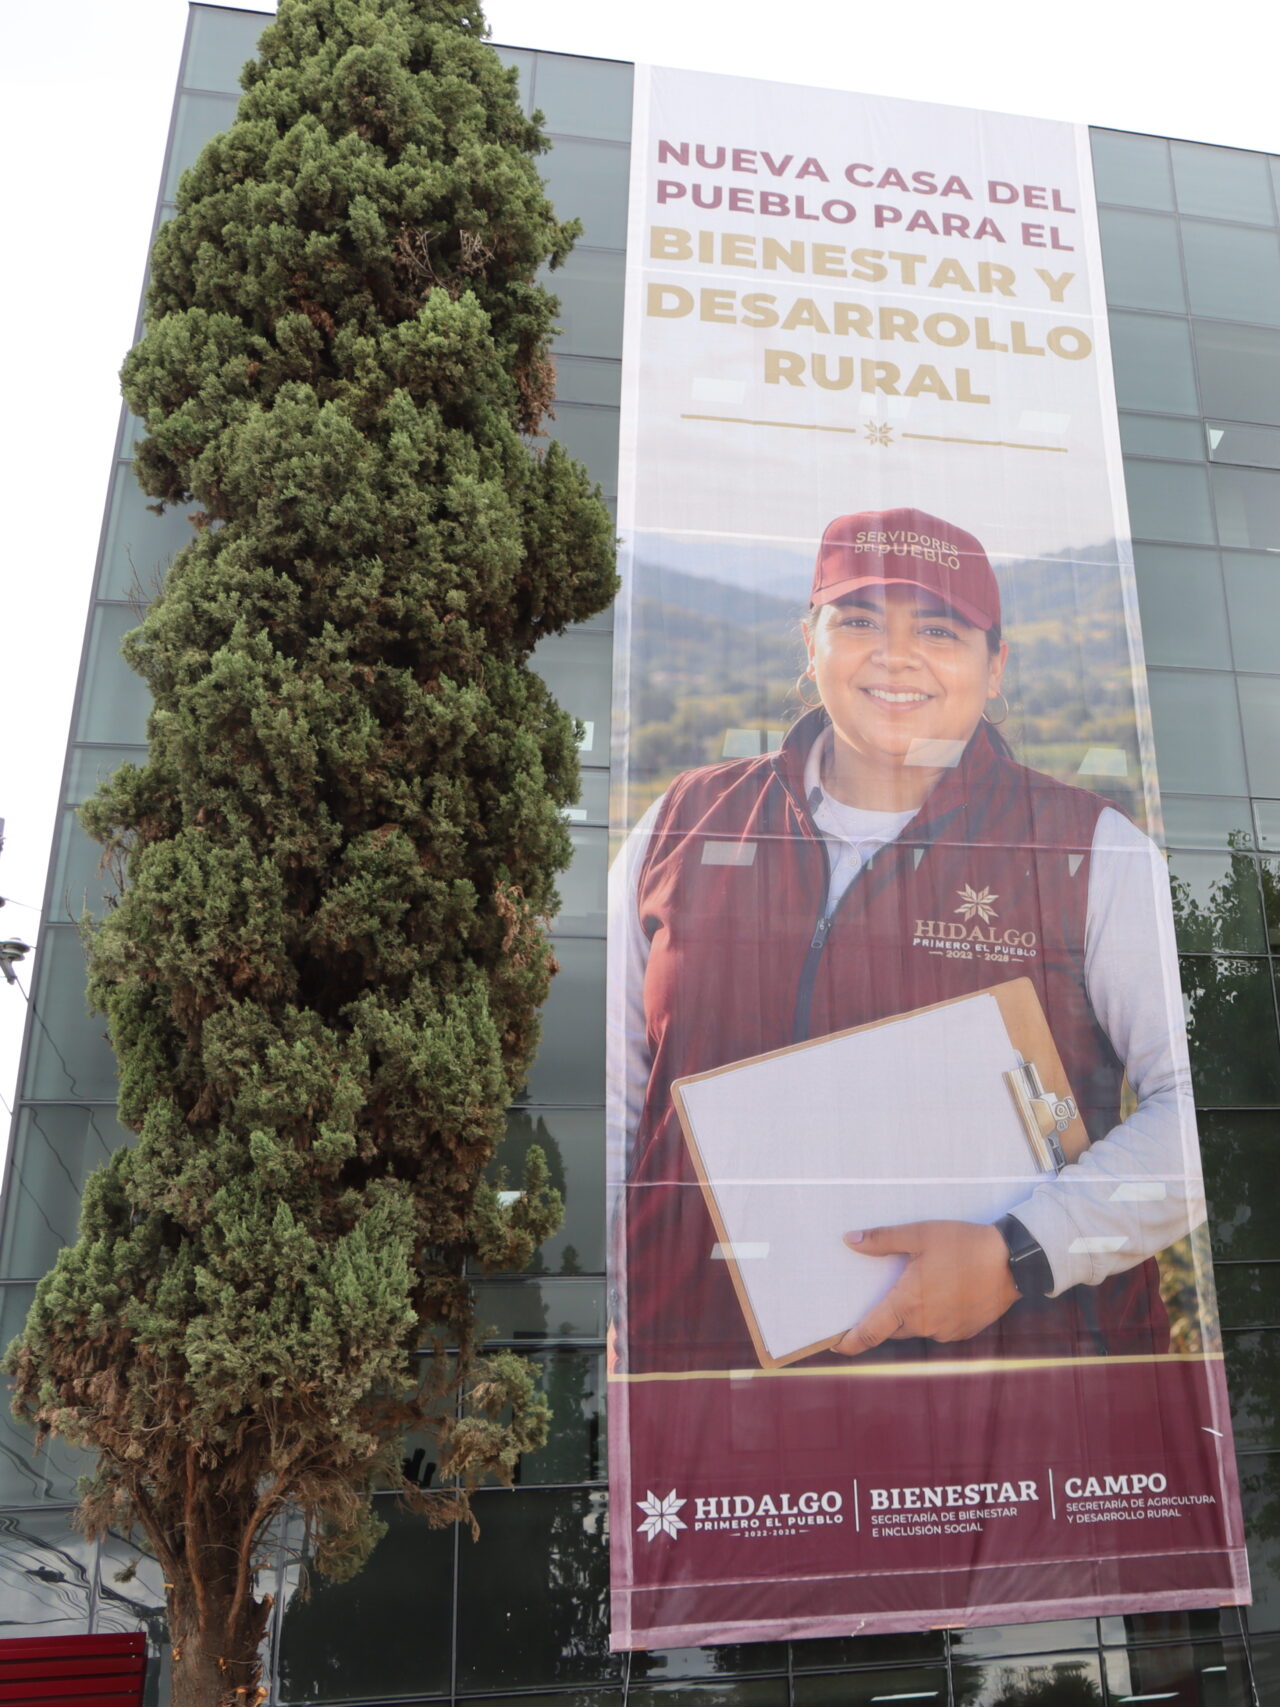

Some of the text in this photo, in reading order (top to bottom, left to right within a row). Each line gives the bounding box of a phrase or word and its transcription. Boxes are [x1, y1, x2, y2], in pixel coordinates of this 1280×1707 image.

[658, 139, 1076, 214] NUEVA CASA DEL
[656, 179, 1075, 252] PUEBLO PARA EL
[650, 225, 1076, 302] BIENESTAR Y
[646, 282, 1093, 361] DESARROLLO
[764, 348, 991, 404] RURAL
[855, 543, 960, 570] DEL PUEBLO
[856, 531, 958, 556] SERVIDORES
[914, 920, 1036, 947] HIDALGO
[913, 938, 1037, 957] PRIMERO EL PUEBLO
[946, 950, 973, 959] 2022
[985, 954, 1009, 962] 2028
[870, 1480, 1039, 1510] BIENESTAR
[1065, 1473, 1167, 1498] CAMPO
[695, 1491, 843, 1519] HIDALGO
[871, 1507, 1017, 1525] SECRETARÍA DE BIENESTAR
[1066, 1495, 1216, 1512] SECRETARÍA DE AGRICULTURA
[1067, 1509, 1181, 1524] Y DESARROLLO RURAL
[695, 1515, 843, 1531] PRIMERO EL PUEBLO
[872, 1523, 983, 1537] E INCLUSIÓN SOCIAL
